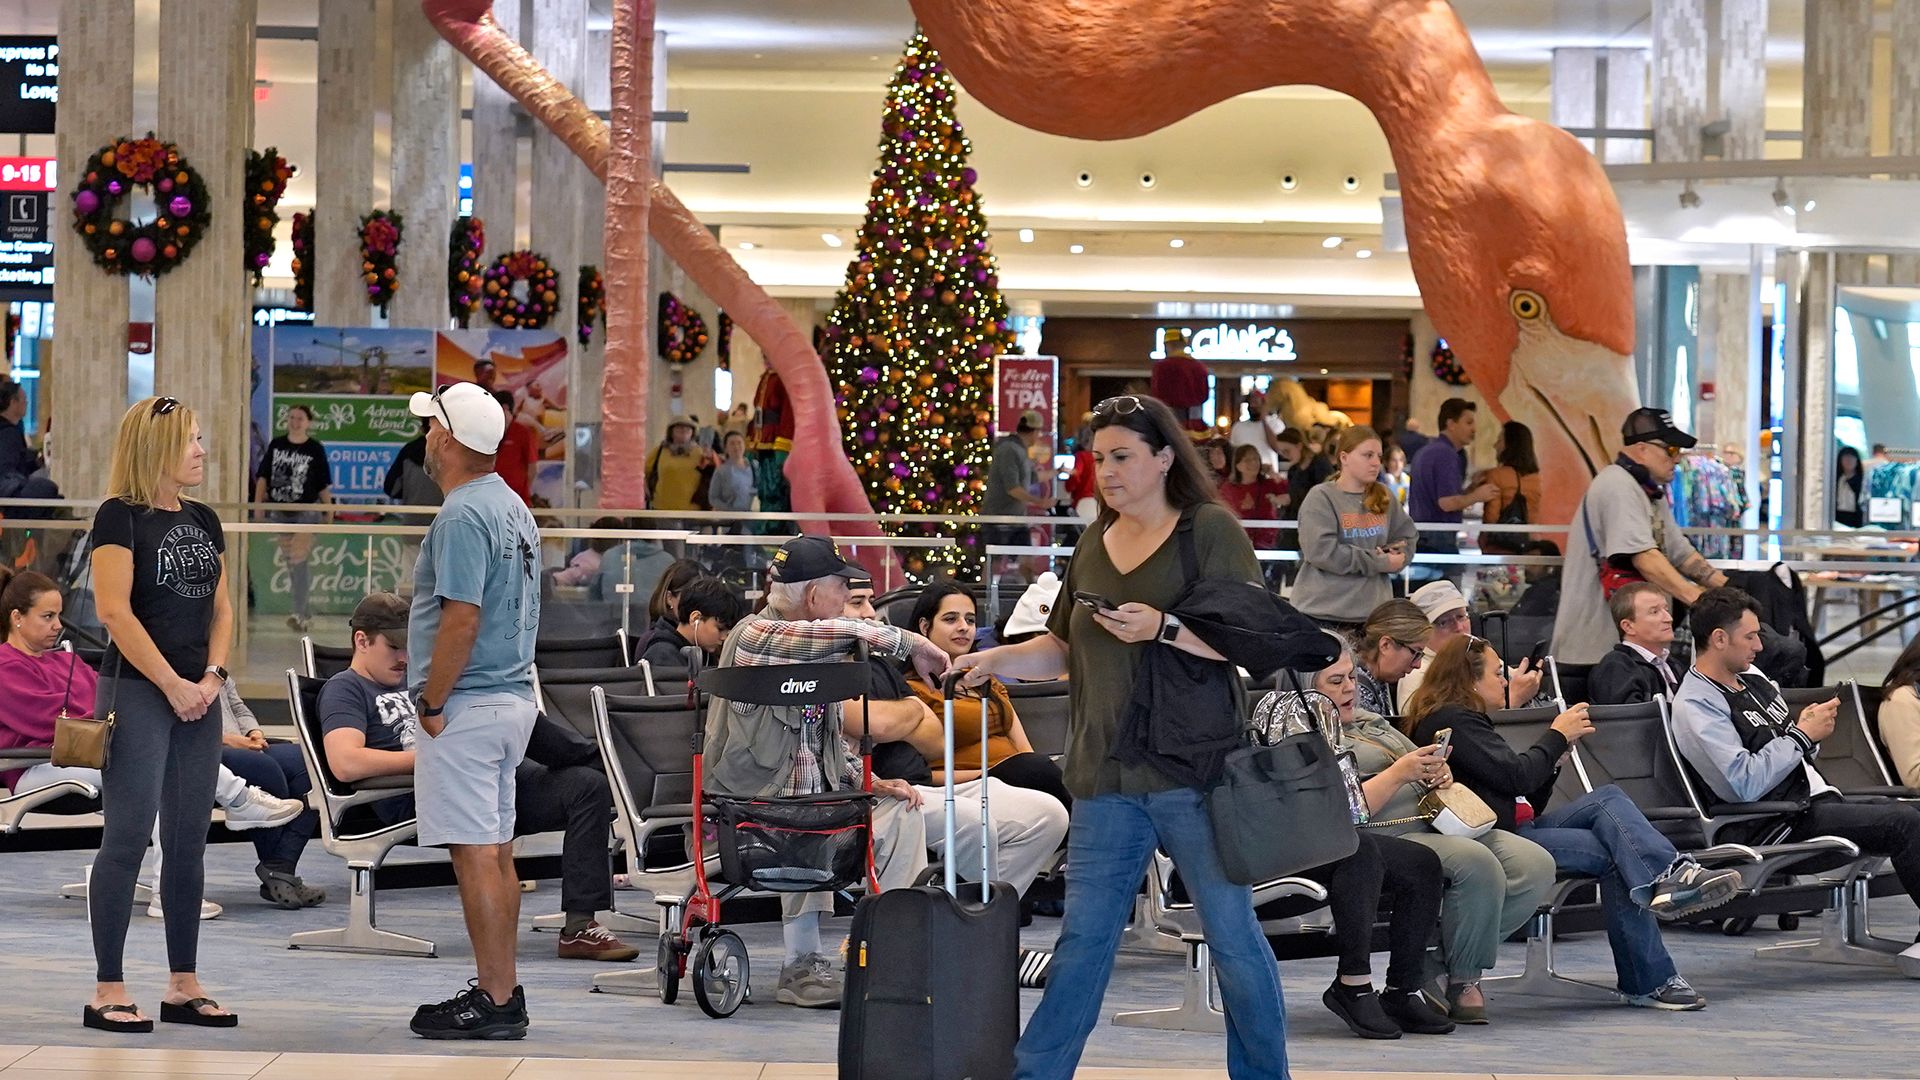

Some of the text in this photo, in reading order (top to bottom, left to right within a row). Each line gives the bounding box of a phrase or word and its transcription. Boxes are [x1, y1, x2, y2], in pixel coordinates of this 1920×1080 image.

[2, 164, 41, 182] 9-15
[14, 241, 54, 254] Country
[1005, 389, 1049, 409] TPA
[368, 416, 407, 430] Island
[327, 449, 391, 463] ORIDA'S
[166, 526, 205, 543] NEW YORK
[270, 564, 382, 593] Grdens
[174, 581, 212, 596] NINETEEN
[780, 678, 817, 694] drive
